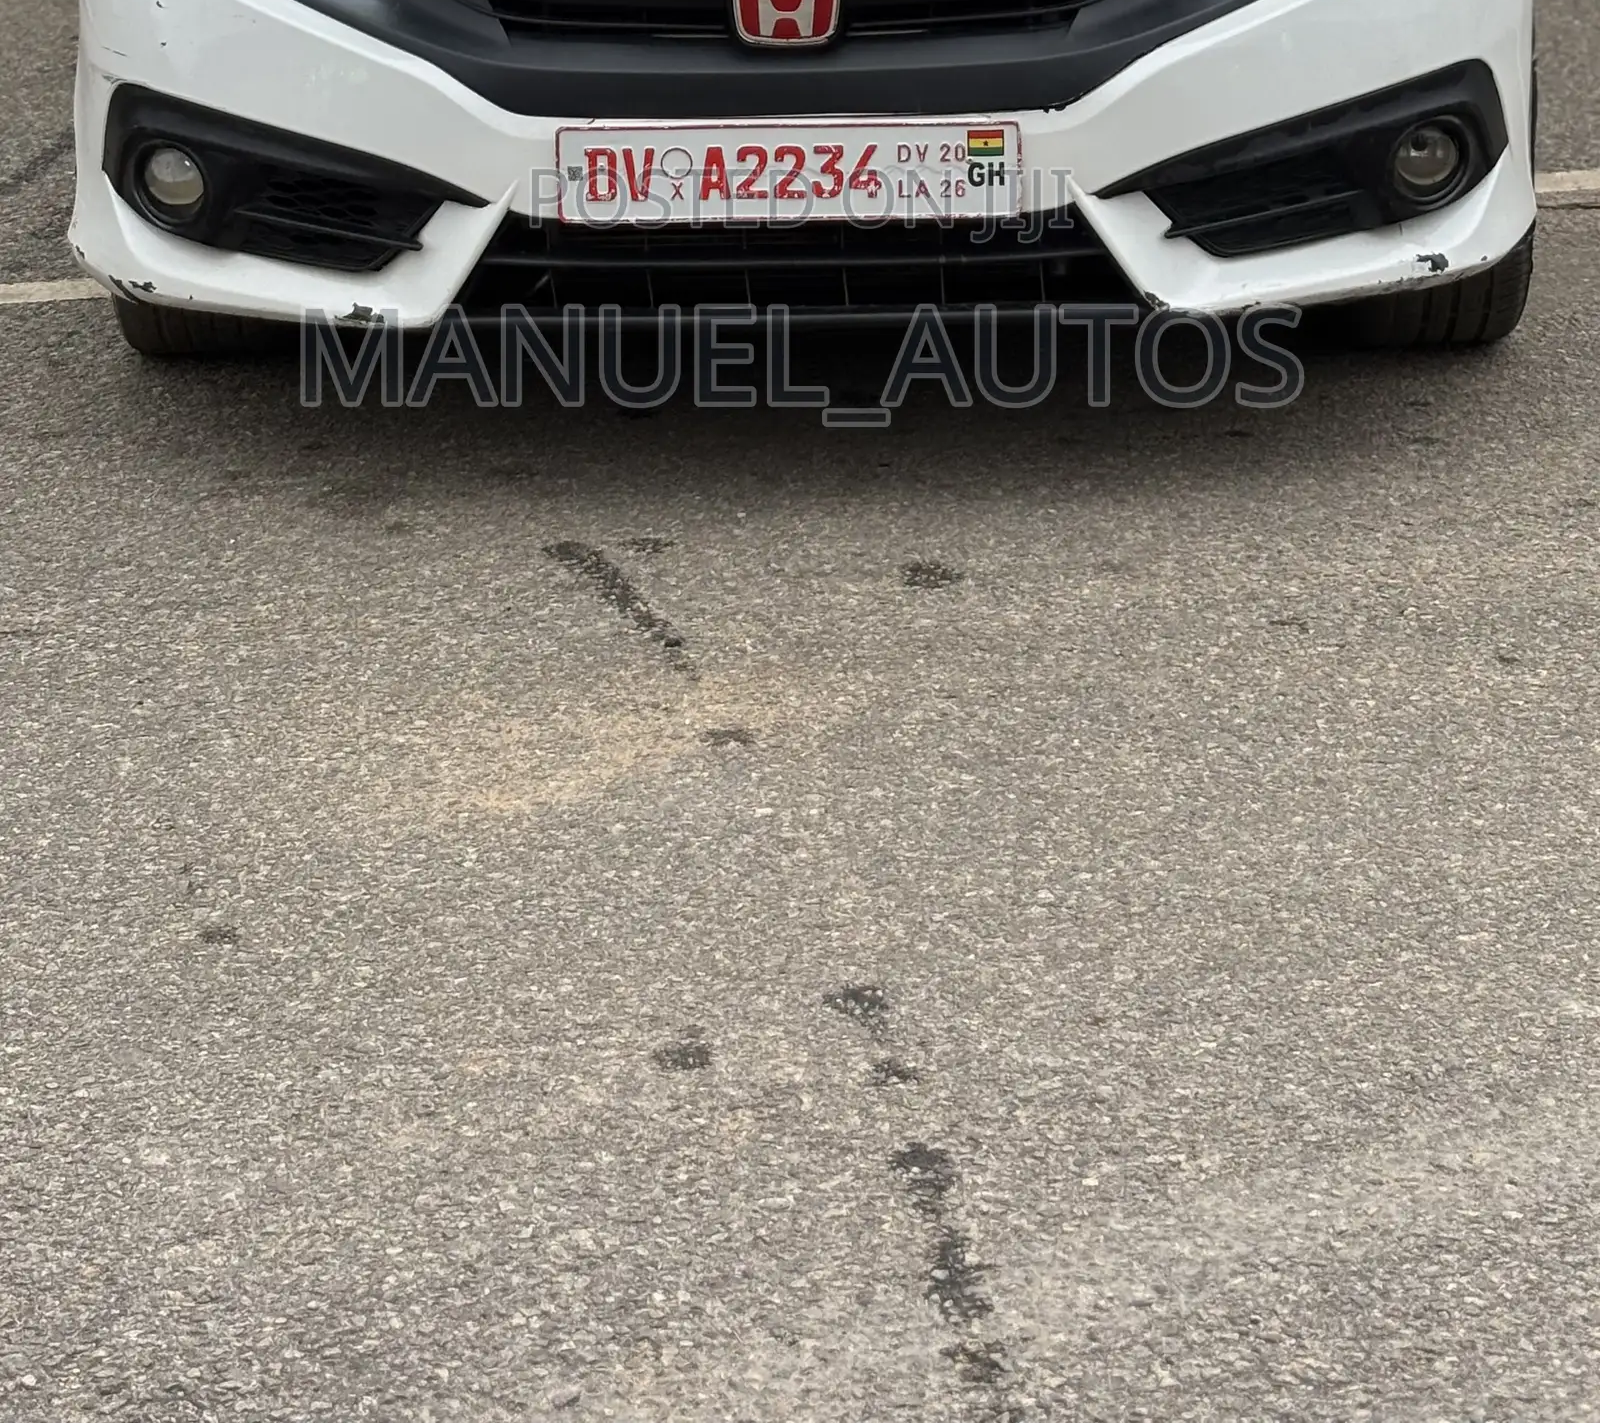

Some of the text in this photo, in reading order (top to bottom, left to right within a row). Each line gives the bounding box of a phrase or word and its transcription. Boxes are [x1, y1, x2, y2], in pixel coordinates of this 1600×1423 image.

[897, 143, 966, 163] DV 20
[584, 144, 882, 202] DV A2234
[967, 161, 1005, 187] GH
[898, 178, 967, 199] LA 26
